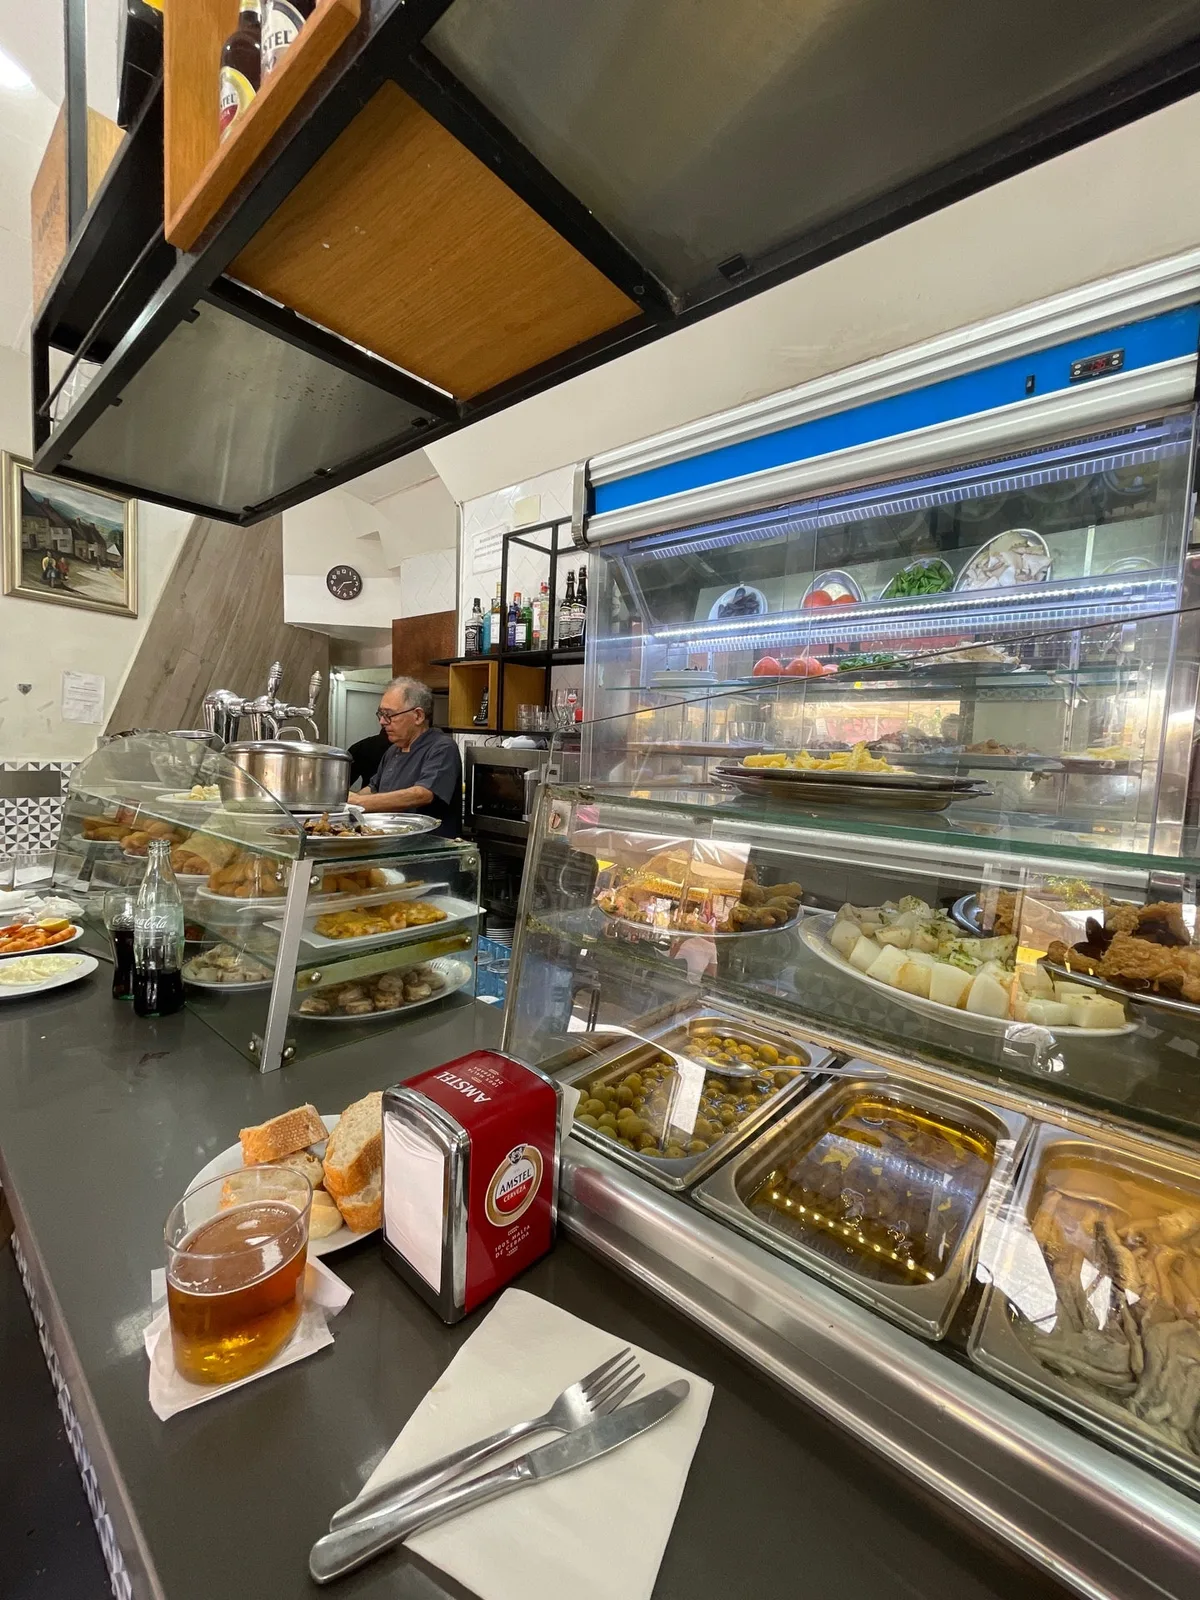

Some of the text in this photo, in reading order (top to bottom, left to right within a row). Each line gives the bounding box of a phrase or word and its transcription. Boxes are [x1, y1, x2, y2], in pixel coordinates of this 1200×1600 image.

[435, 1071, 492, 1103] AMSTEL
[499, 1168, 532, 1195] AMSTEL
[503, 1184, 527, 1203] CERVEZA
[495, 1232, 529, 1259] DE CEBADA
[511, 1225, 530, 1241] MALTA
